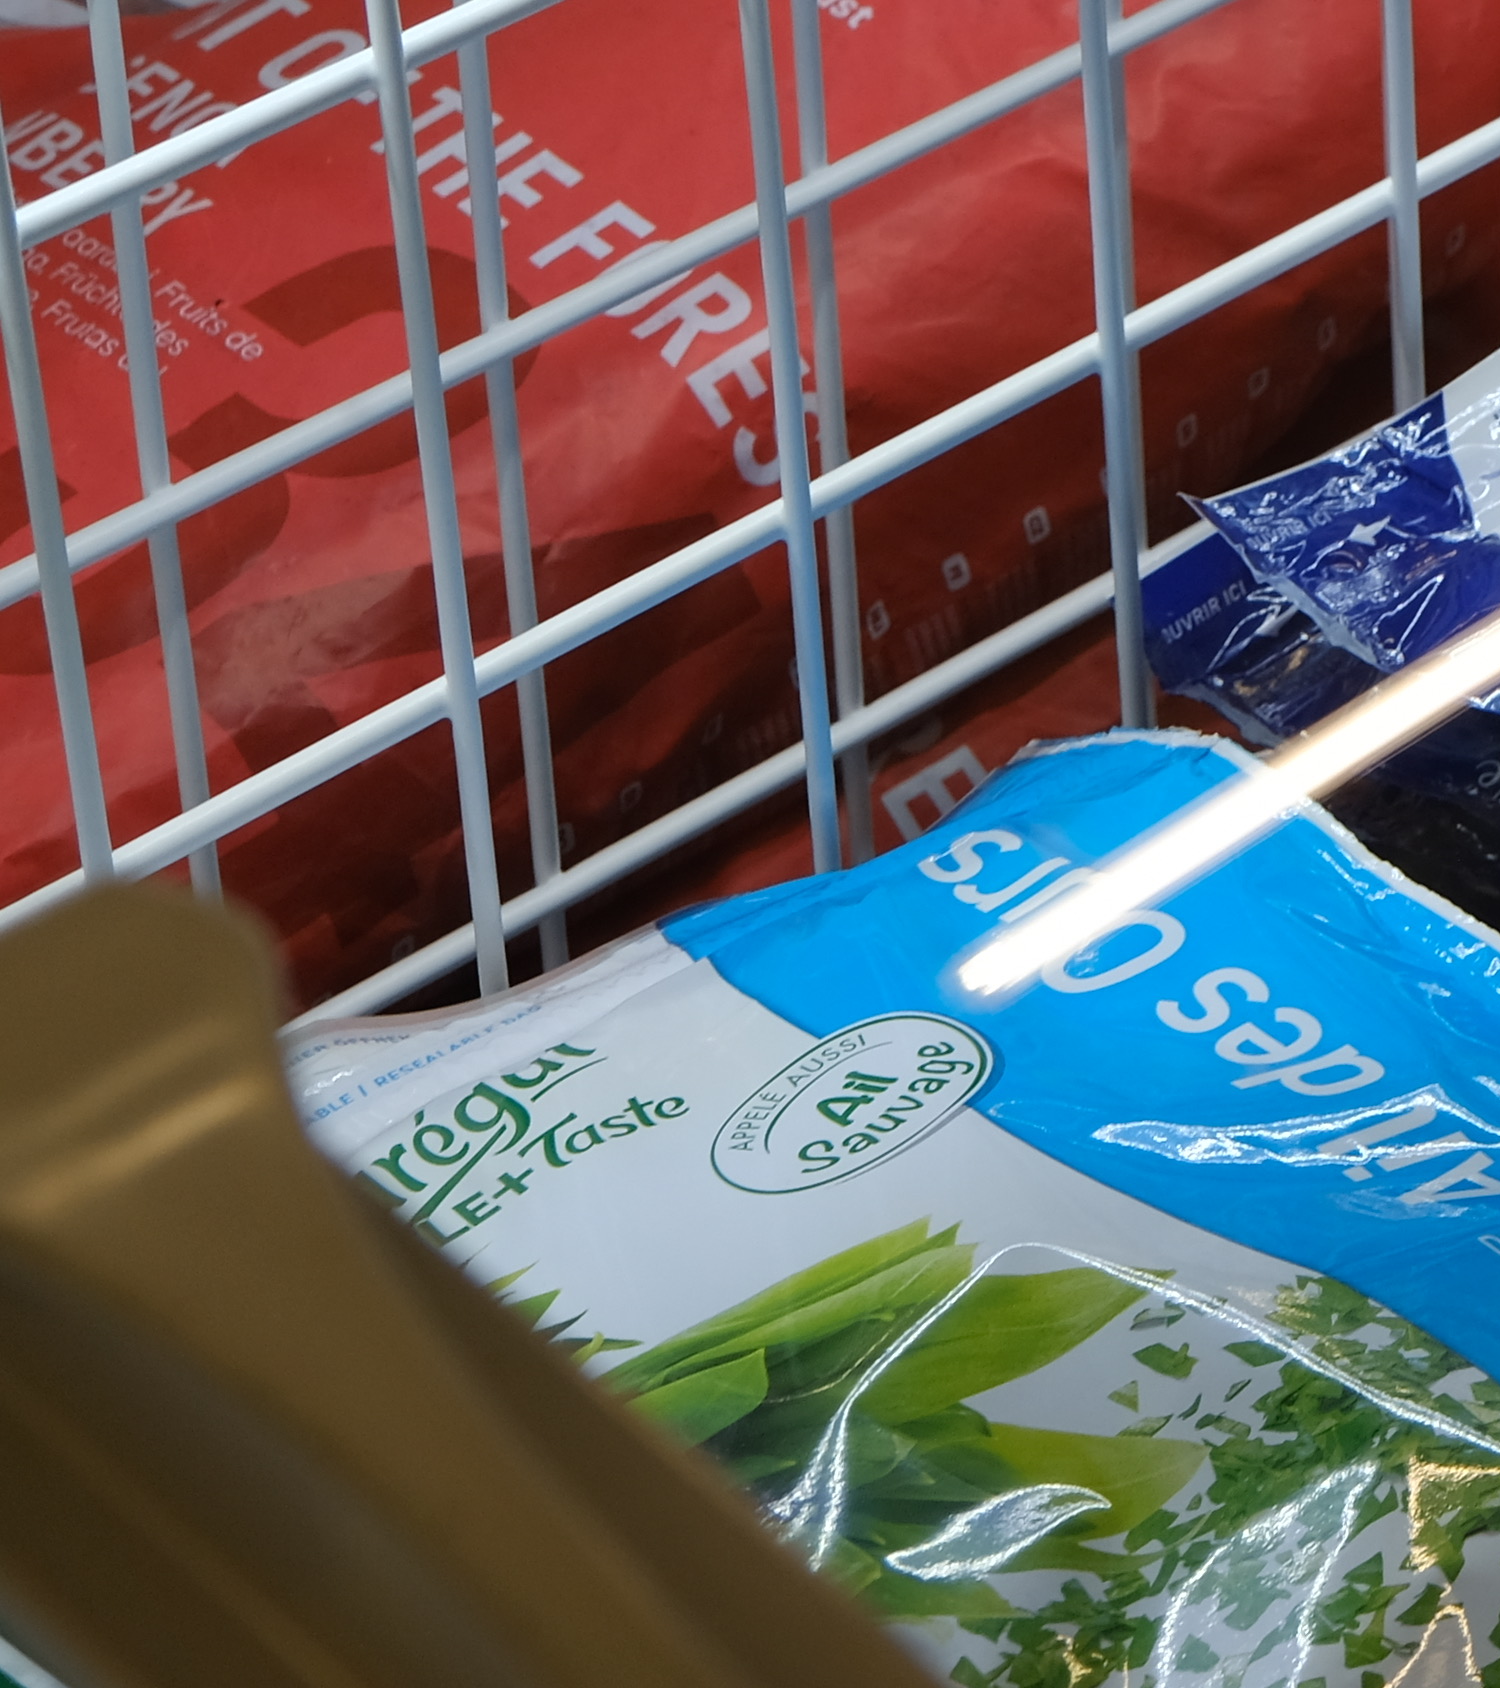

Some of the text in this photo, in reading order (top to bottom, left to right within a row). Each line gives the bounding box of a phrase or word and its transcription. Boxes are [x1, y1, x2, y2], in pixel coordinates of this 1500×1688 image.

[40, 297, 121, 359] Frutas
[154, 278, 264, 362] Fruits de
[1222, 579, 1249, 611] ICI
[1155, 966, 1386, 1097] des
[728, 1033, 867, 1153] APPELÉ AUSSI
[797, 1040, 976, 1175] Sauvage
[815, 1069, 900, 1128] Ail
